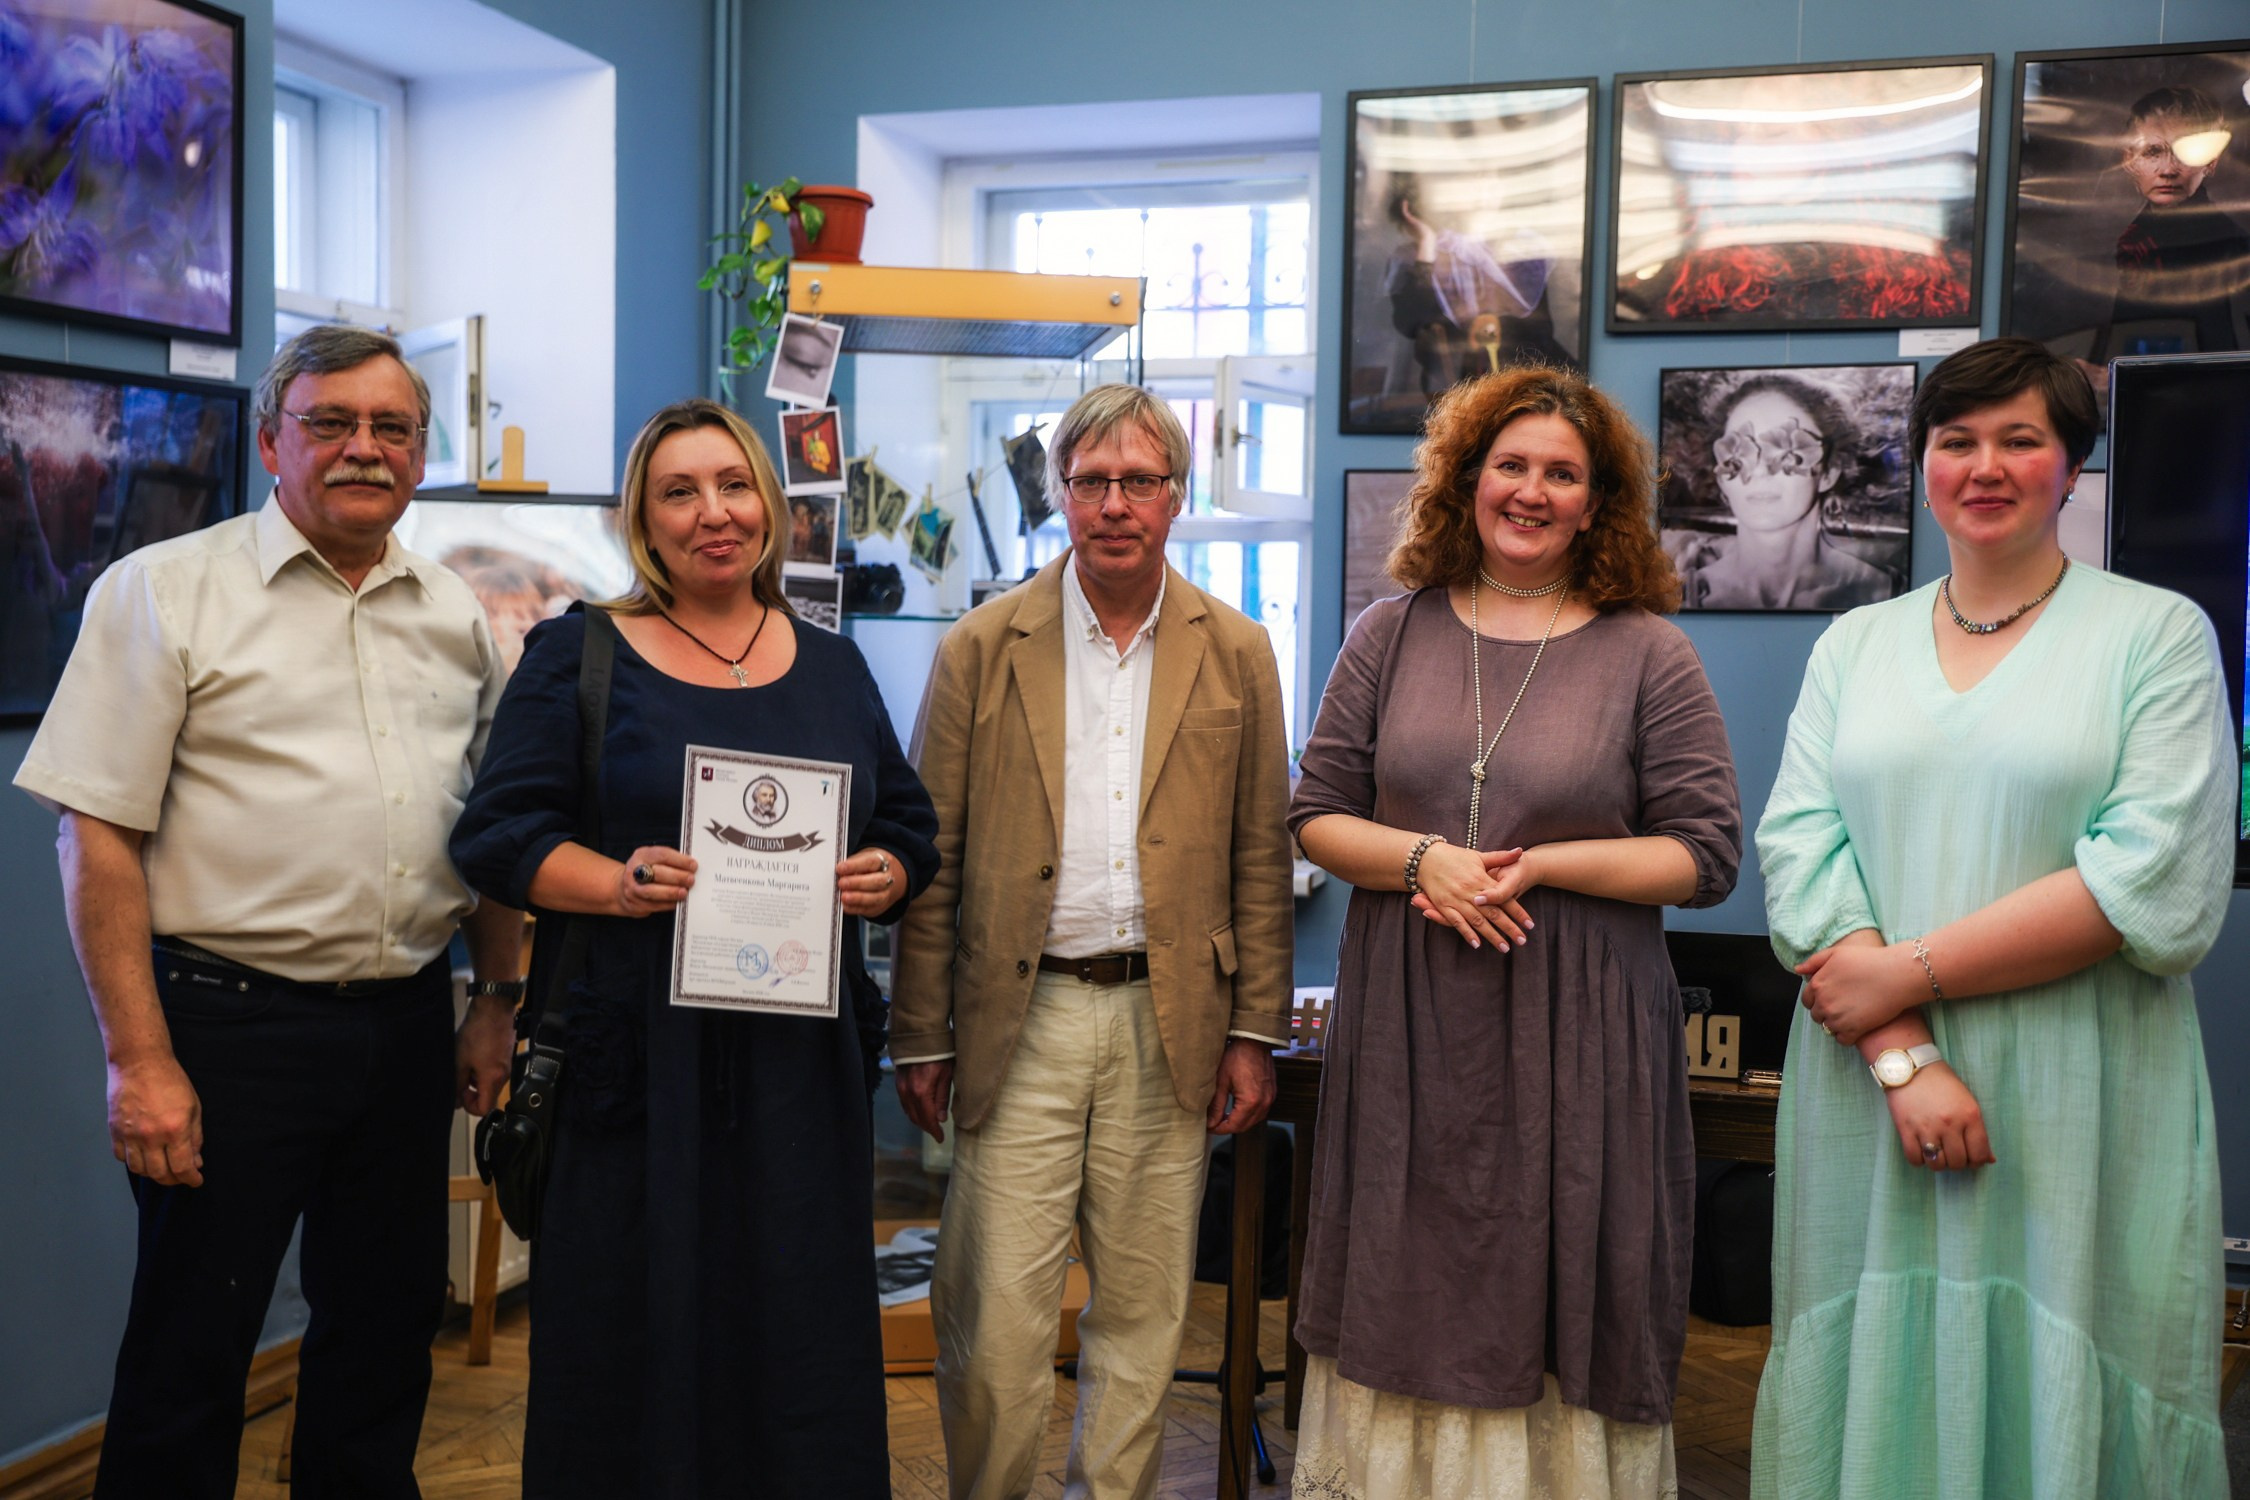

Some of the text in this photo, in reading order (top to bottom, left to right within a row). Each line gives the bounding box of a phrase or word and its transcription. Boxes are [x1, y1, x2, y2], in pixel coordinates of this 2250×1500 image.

[742, 834, 785, 850] ДИПЛОМ
[727, 857, 800, 874] НАГРАЖДАЕТСЯ
[767, 878, 810, 892] Маргарита
